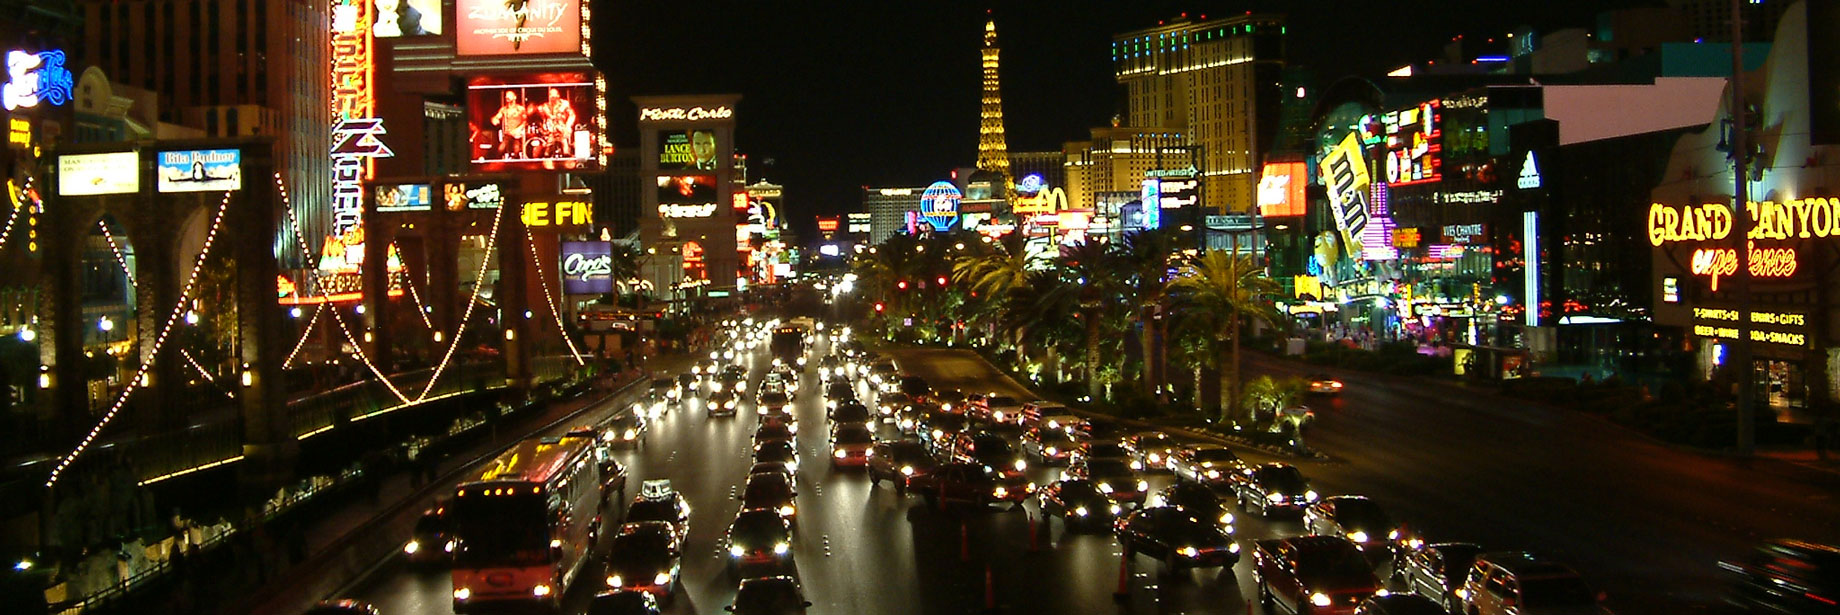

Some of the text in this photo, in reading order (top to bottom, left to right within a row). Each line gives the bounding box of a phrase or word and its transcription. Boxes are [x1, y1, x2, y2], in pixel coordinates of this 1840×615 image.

[640, 106, 732, 121] Monte Carlo
[664, 143, 691, 153] LANCE
[660, 153, 695, 163] BURTON
[1648, 203, 1732, 247] GRAND
[1691, 241, 1797, 291] expeience
[1769, 331, 1805, 346] SNACKS
